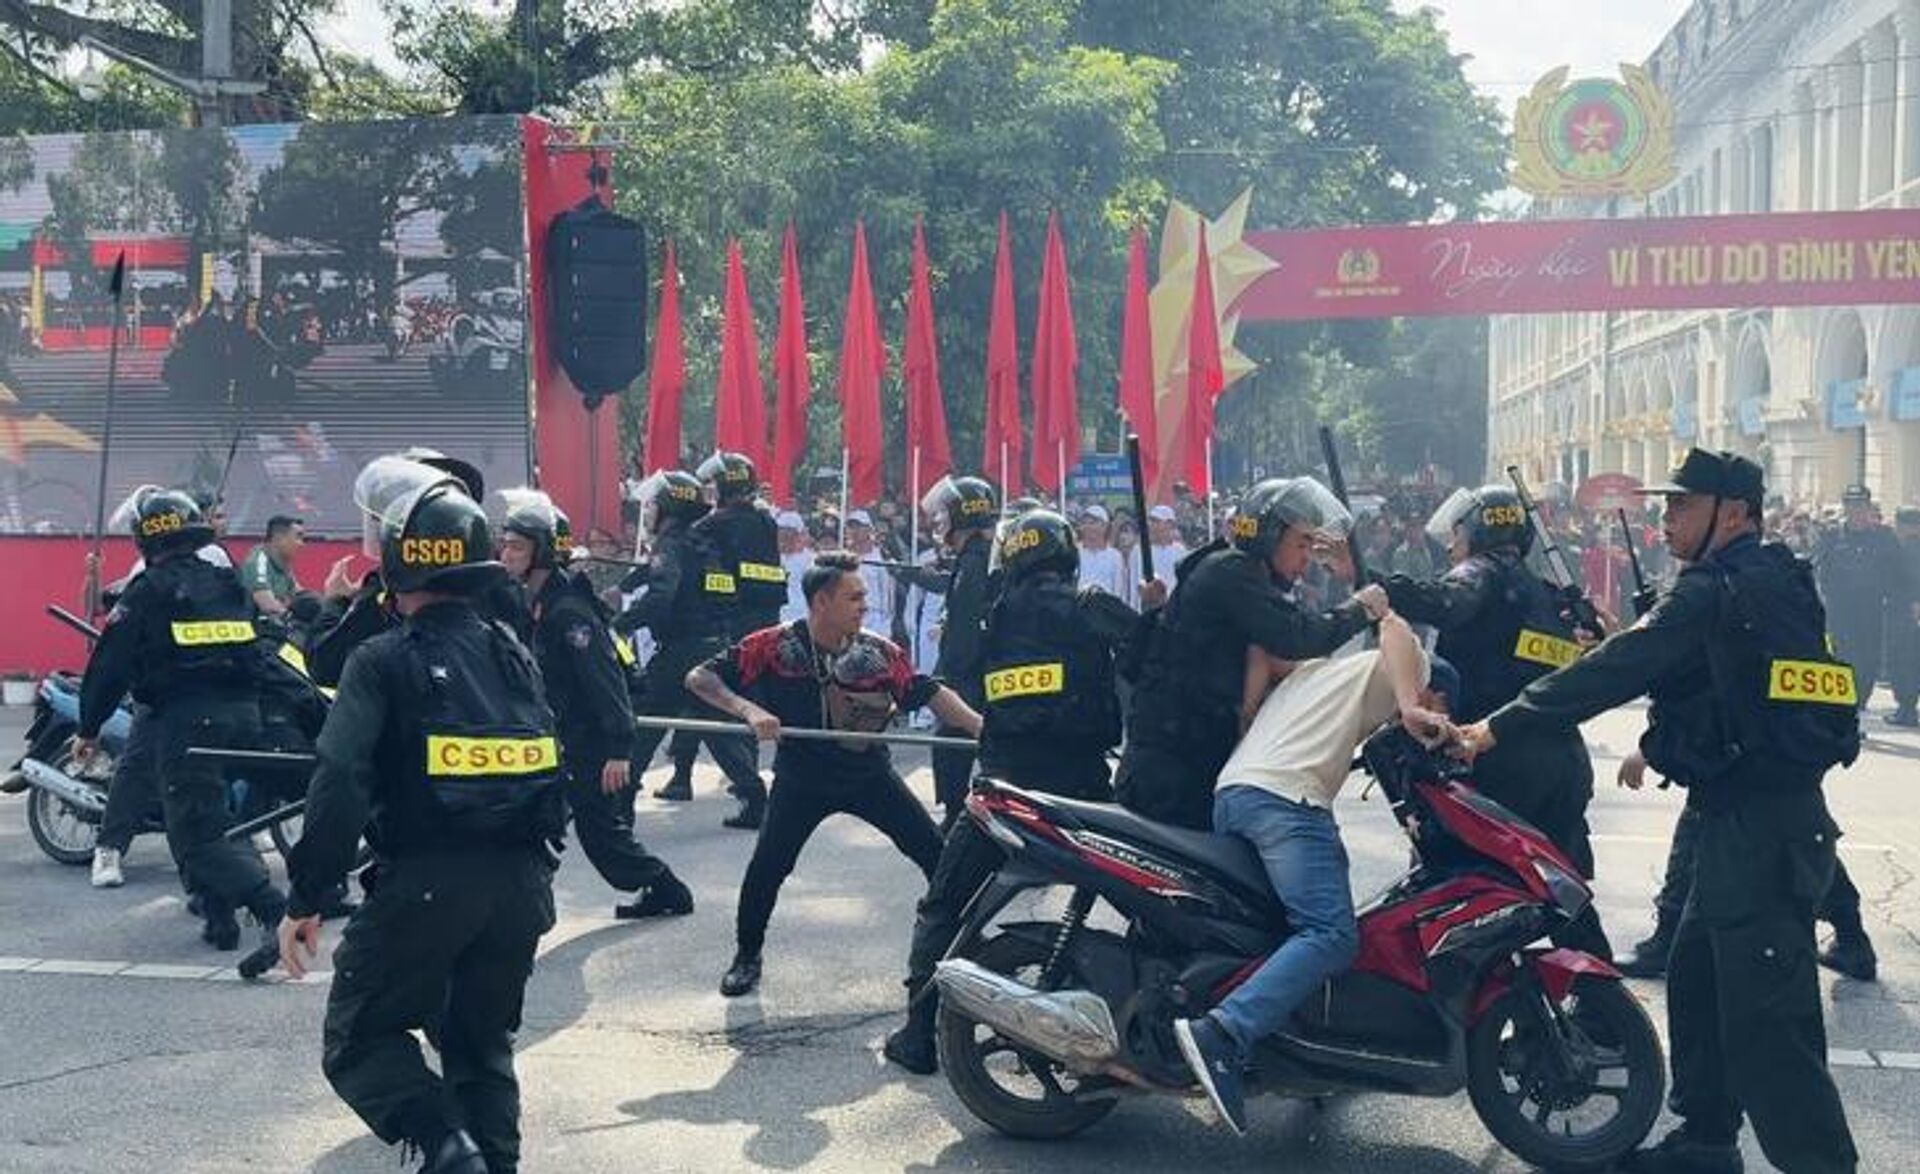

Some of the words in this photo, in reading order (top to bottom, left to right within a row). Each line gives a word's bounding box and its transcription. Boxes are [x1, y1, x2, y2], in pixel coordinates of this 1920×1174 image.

[990, 669, 1053, 695] CSCĐ
[1780, 668, 1849, 696] CSCĐ
[441, 743, 543, 767] CSCĐ
